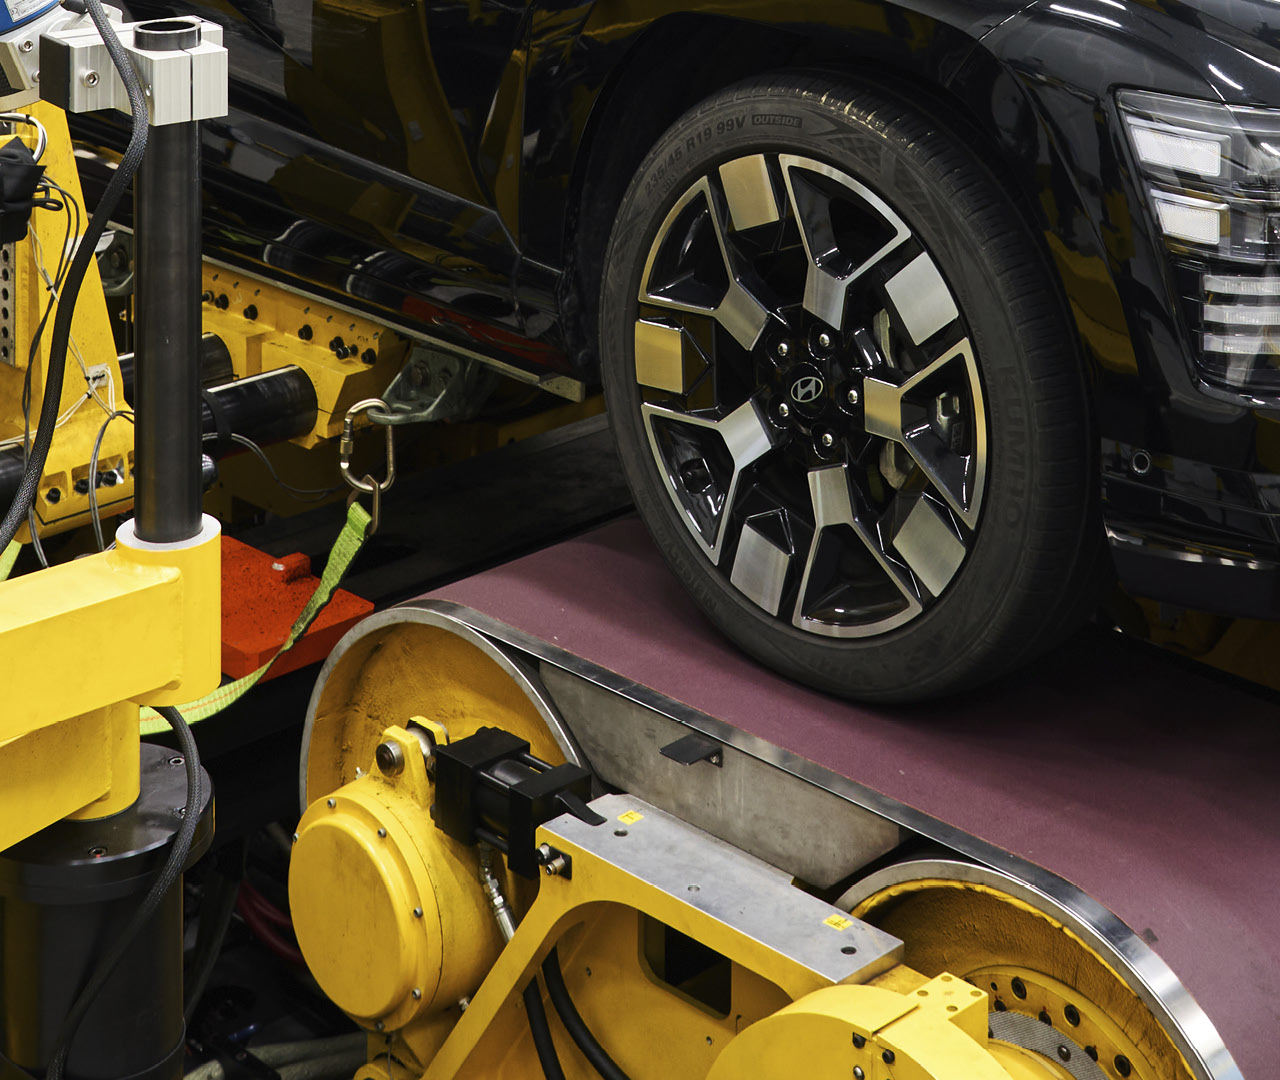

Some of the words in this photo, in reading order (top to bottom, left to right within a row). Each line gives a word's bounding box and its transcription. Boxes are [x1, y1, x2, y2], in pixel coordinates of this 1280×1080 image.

[645, 148, 682, 195] 235/45
[686, 127, 712, 152] R19
[716, 115, 746, 135] 99V
[753, 114, 802, 128] OUTSIDE
[996, 366, 1026, 529] KUMHO
